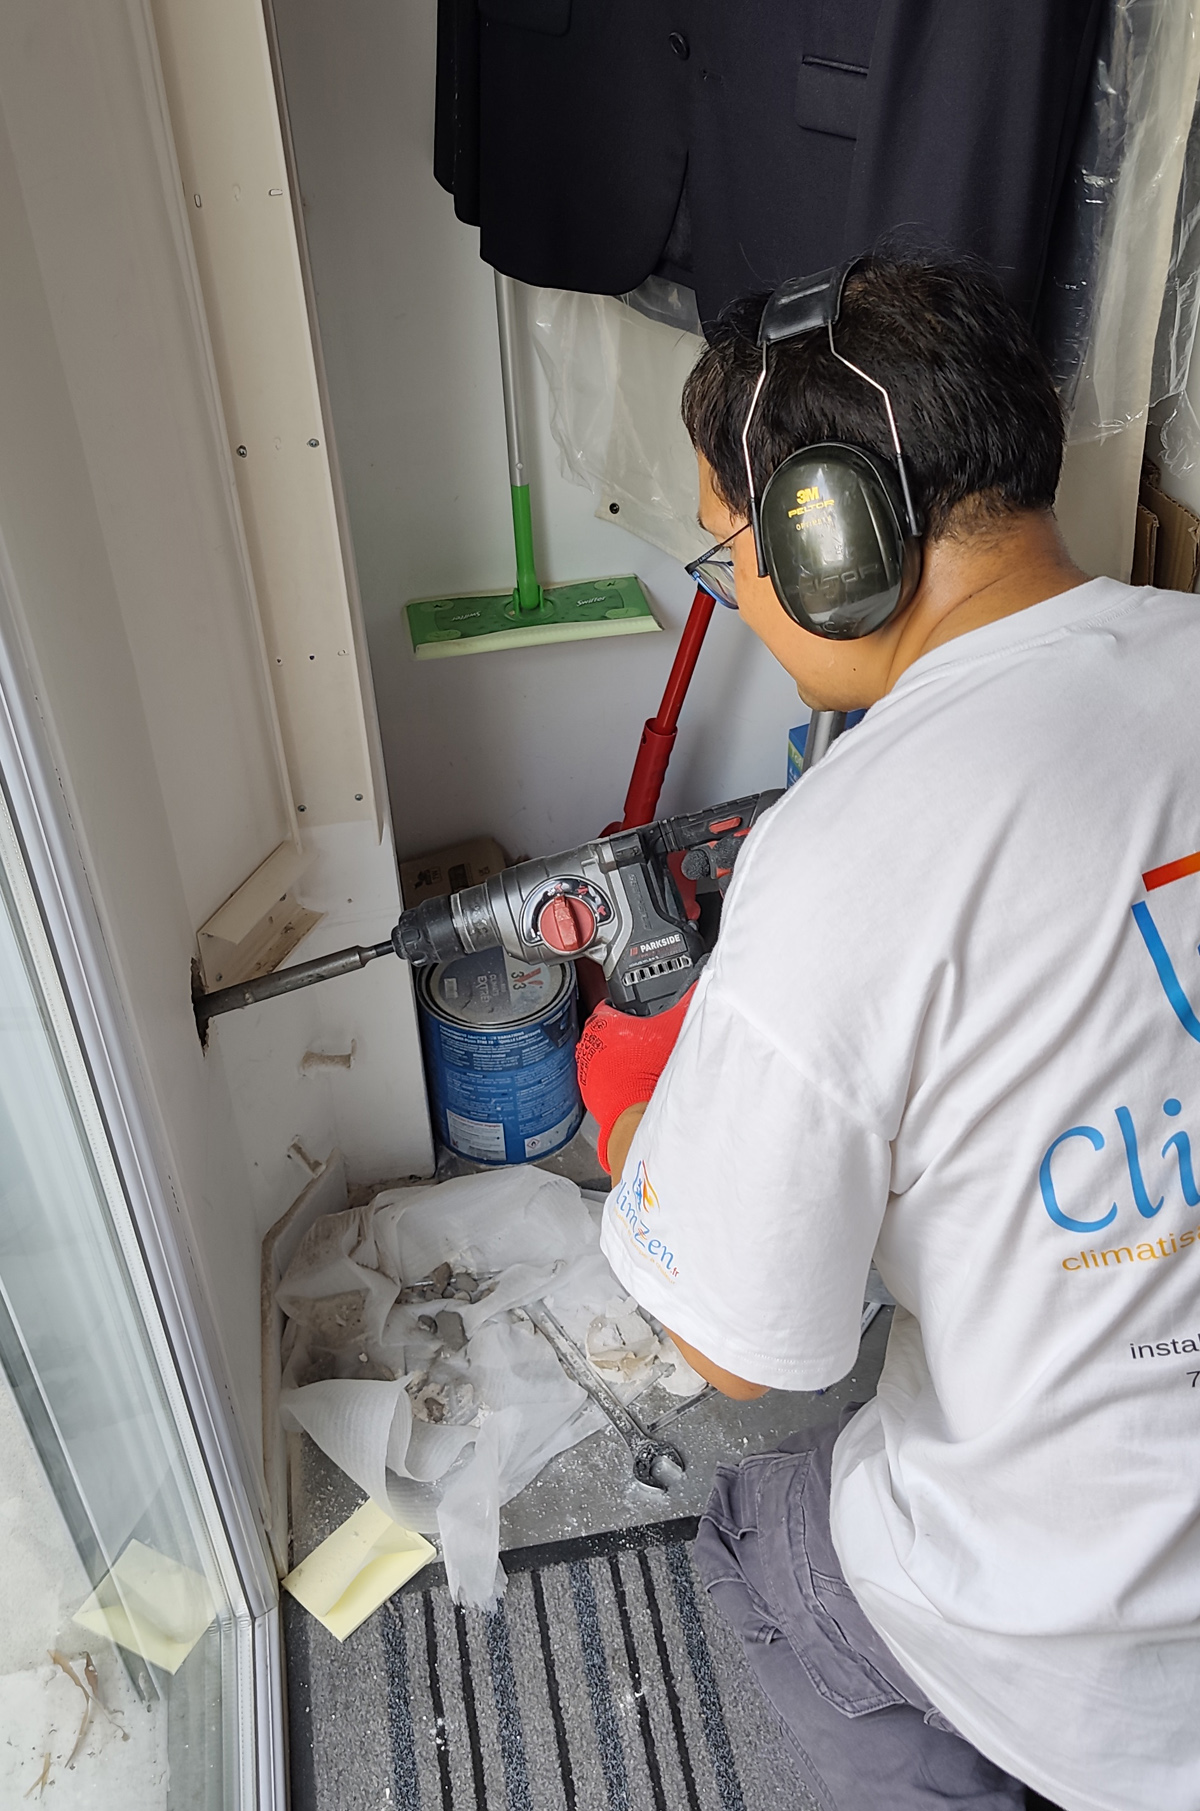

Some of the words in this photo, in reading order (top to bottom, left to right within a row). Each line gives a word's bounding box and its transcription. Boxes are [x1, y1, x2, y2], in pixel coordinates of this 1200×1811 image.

[796, 486, 820, 505] 3M
[788, 499, 835, 519] PELTOR
[577, 596, 607, 607] Swiffer
[640, 934, 681, 953] PARKSIDE
[1062, 1225, 1200, 1271] climatis
